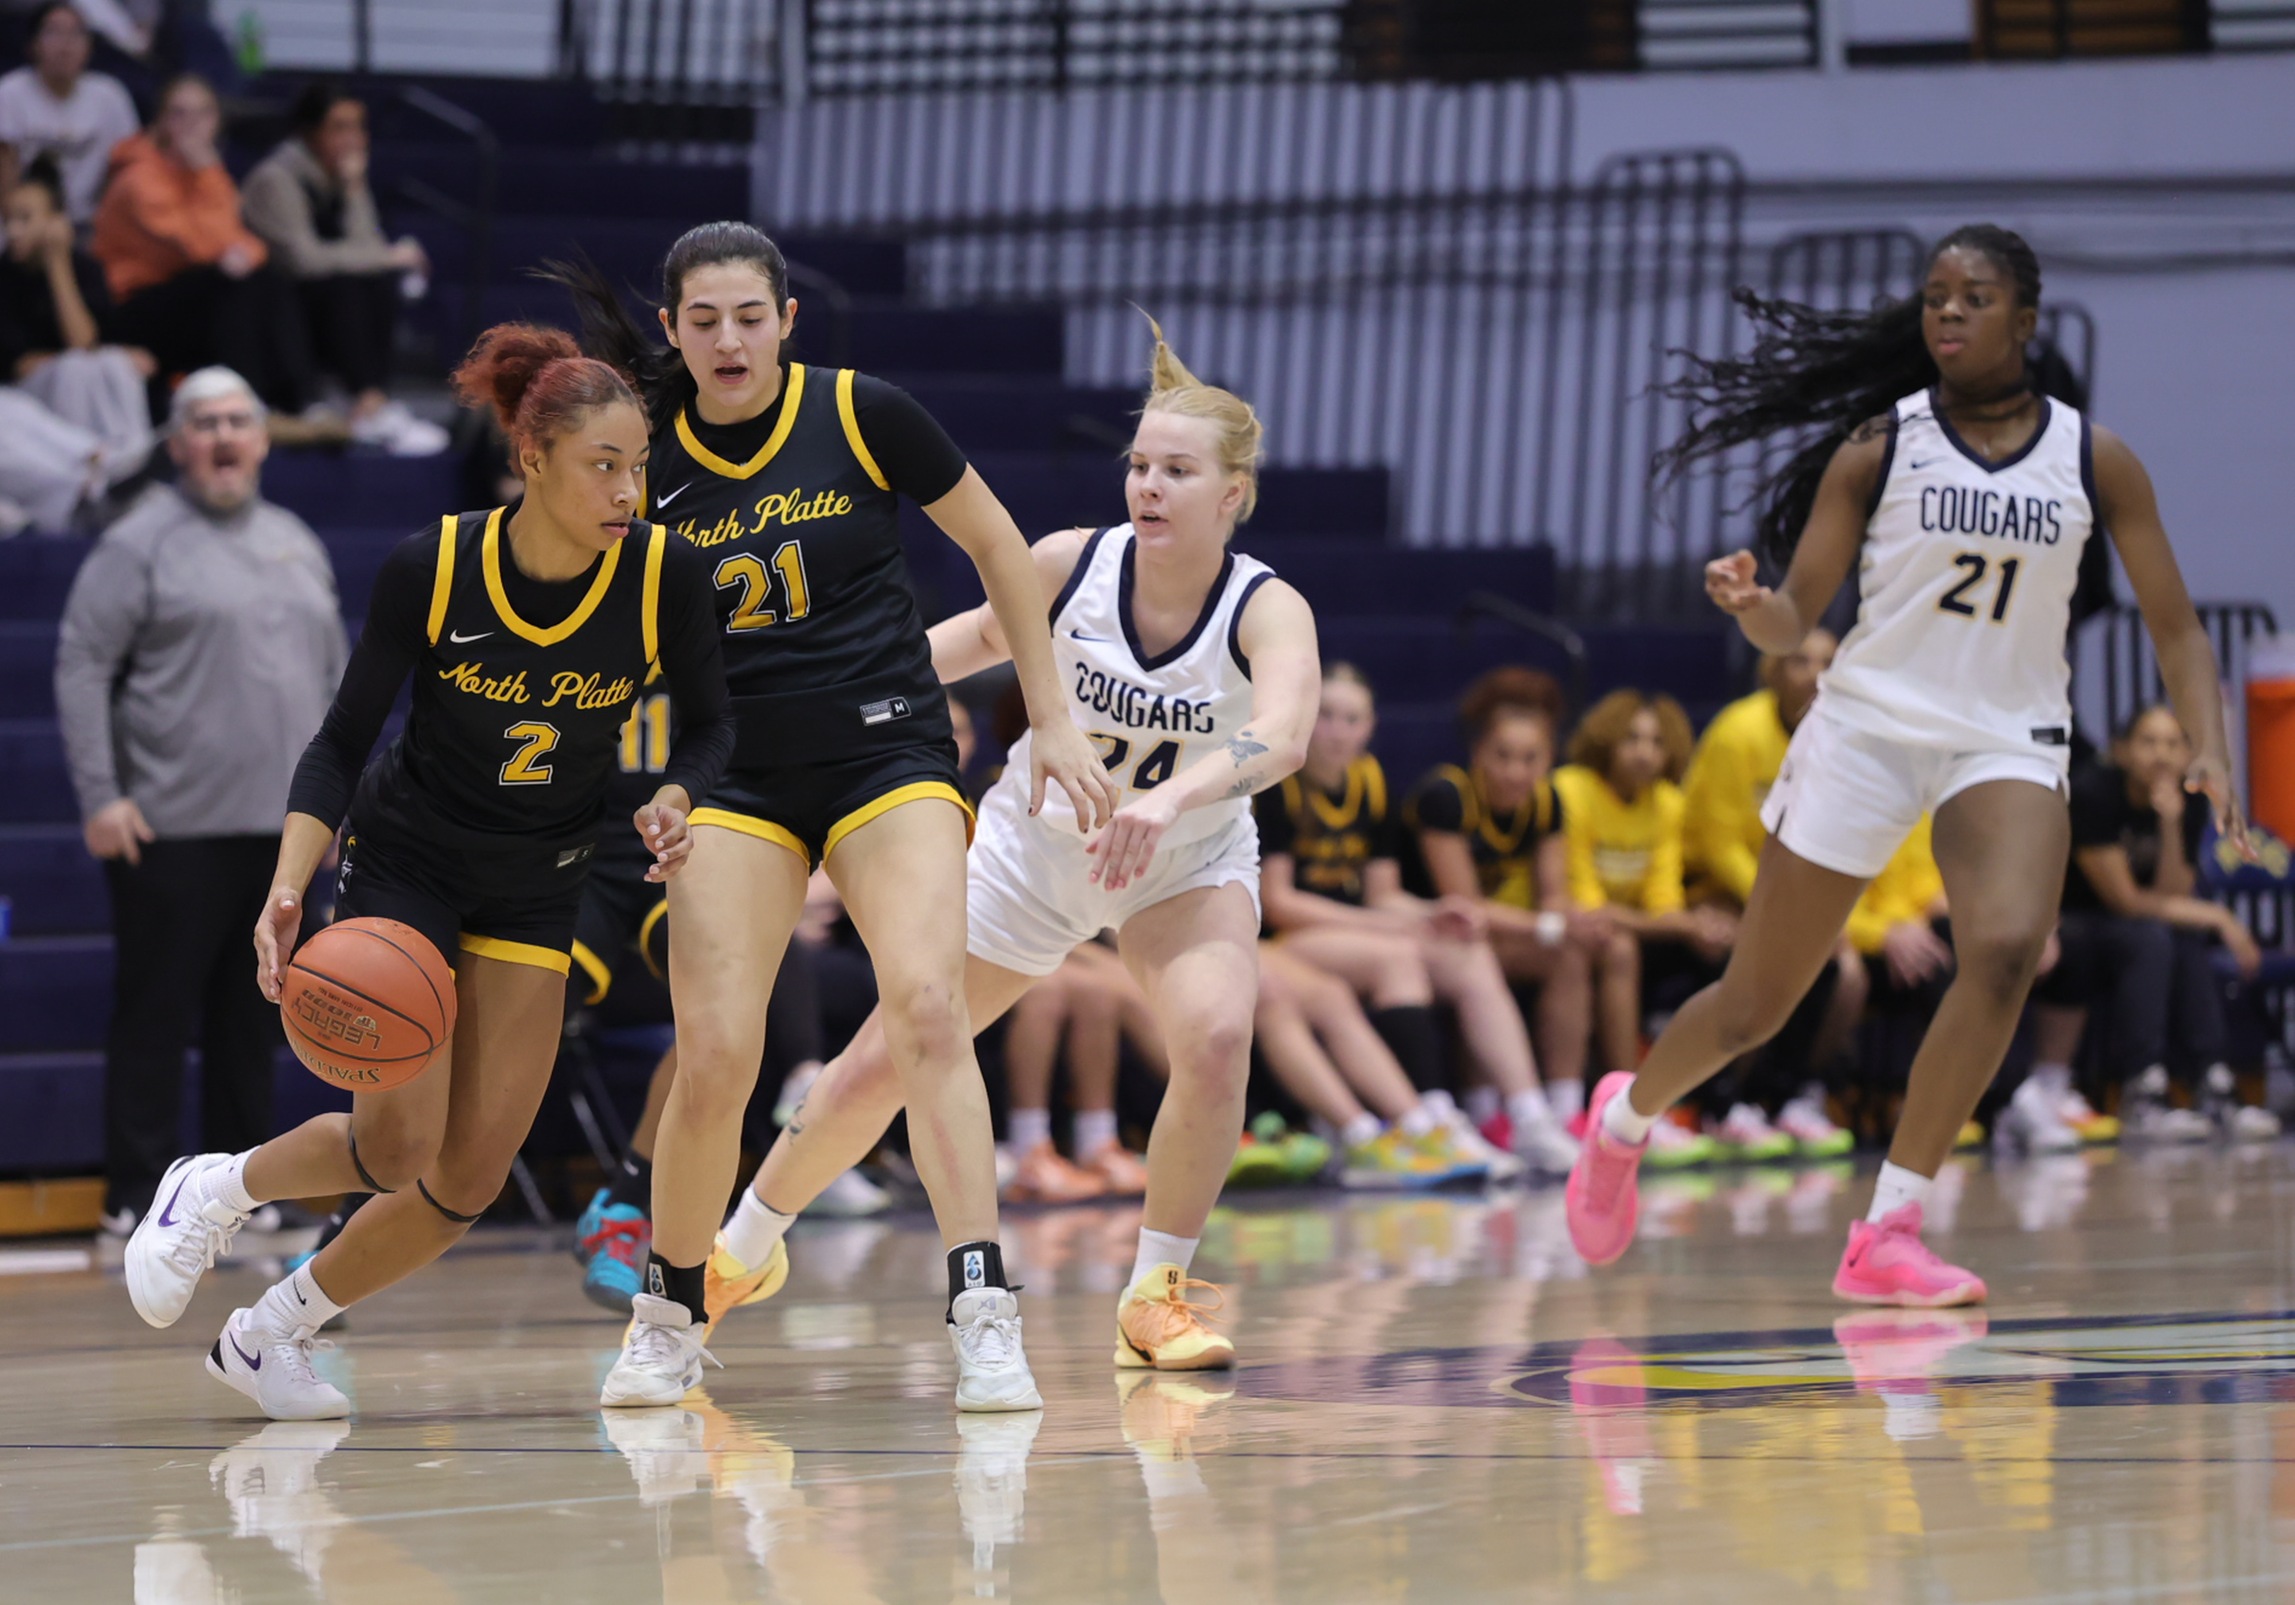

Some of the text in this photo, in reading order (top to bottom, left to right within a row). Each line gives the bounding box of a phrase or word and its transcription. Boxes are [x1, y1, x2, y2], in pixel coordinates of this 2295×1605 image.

[750, 487, 853, 534] Platte
[1920, 486, 2061, 546] COUGARS
[712, 539, 811, 634] 21
[1935, 551, 2022, 624] 21
[438, 661, 634, 710] North Platte
[894, 702, 906, 713] M
[1075, 661, 1215, 734] COUGARS
[498, 720, 561, 786] 2
[291, 996, 382, 1051] LEGACY
[288, 1037, 381, 1084] SPALDI
